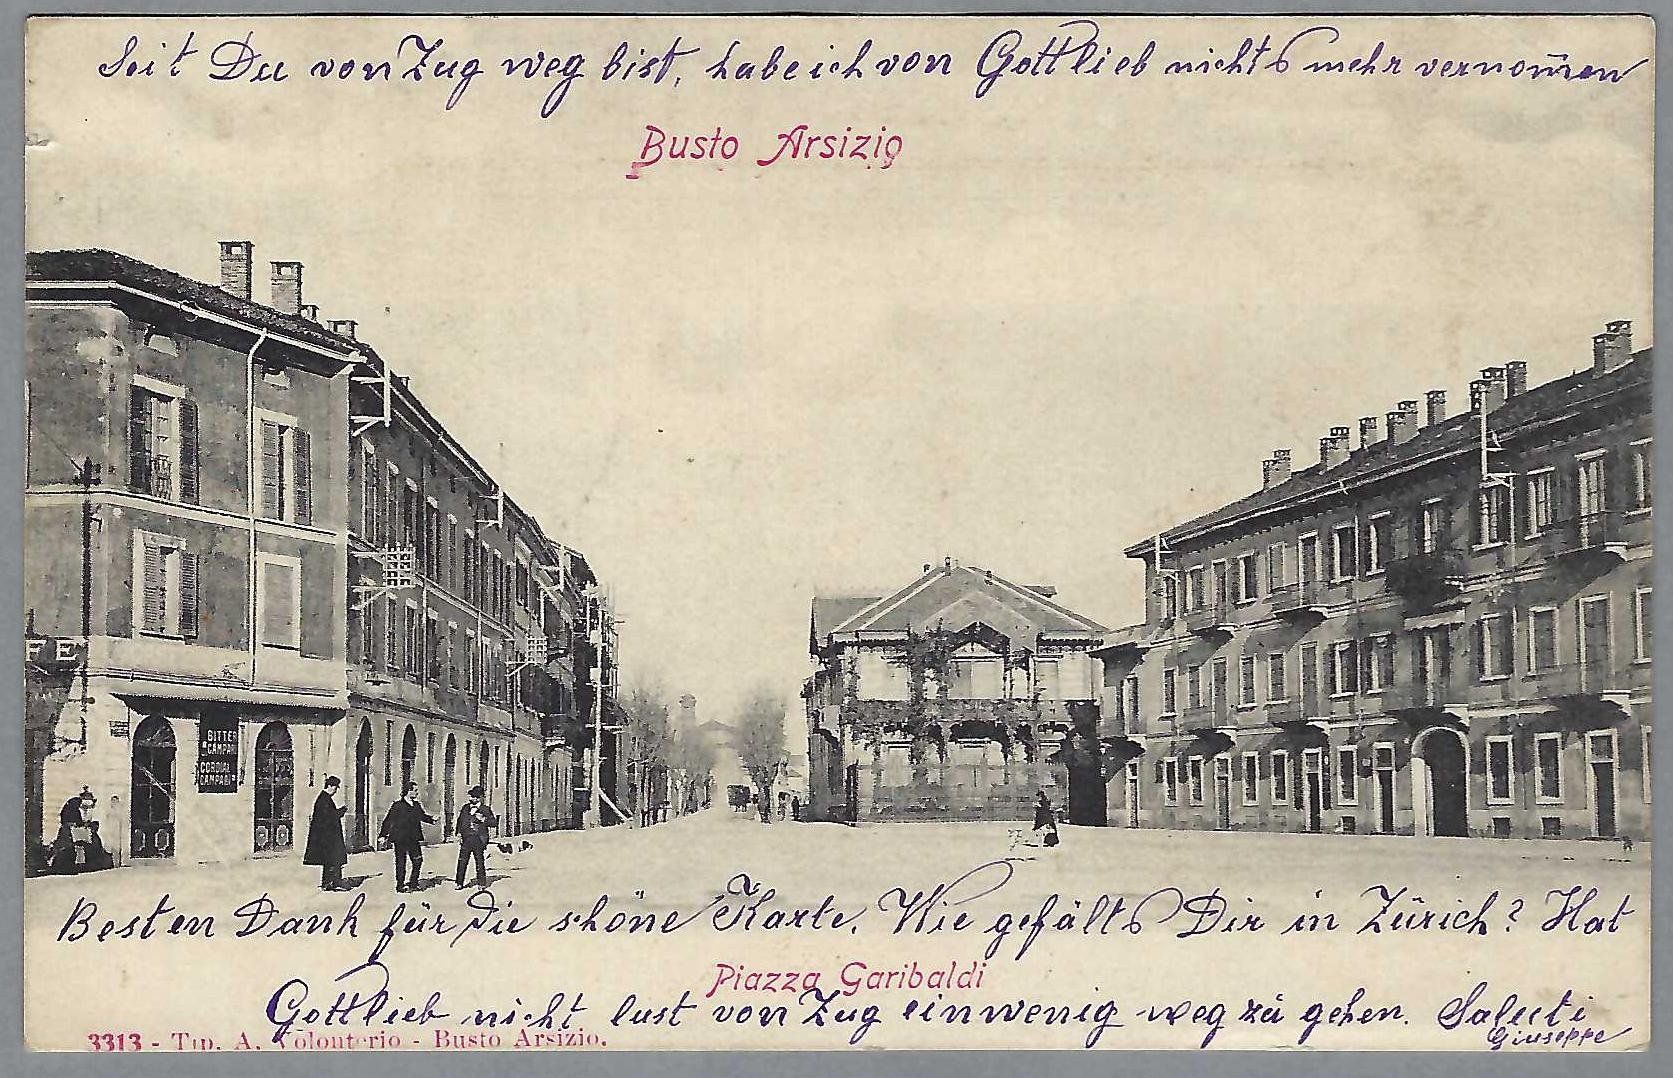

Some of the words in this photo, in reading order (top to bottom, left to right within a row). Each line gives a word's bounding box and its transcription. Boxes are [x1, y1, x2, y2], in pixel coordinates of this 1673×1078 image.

[208, 31, 288, 82] Du
[310, 60, 392, 82] von
[500, 51, 585, 119] weg
[874, 51, 952, 77] von
[207, 729, 238, 742] BITTER
[56, 893, 216, 942] Besten
[233, 892, 366, 938] Dank
[367, 902, 457, 965] für
[1280, 889, 1340, 935] in
[1541, 886, 1636, 935] Hat
[712, 1004, 787, 1028] von
[1136, 1000, 1226, 1050] weg
